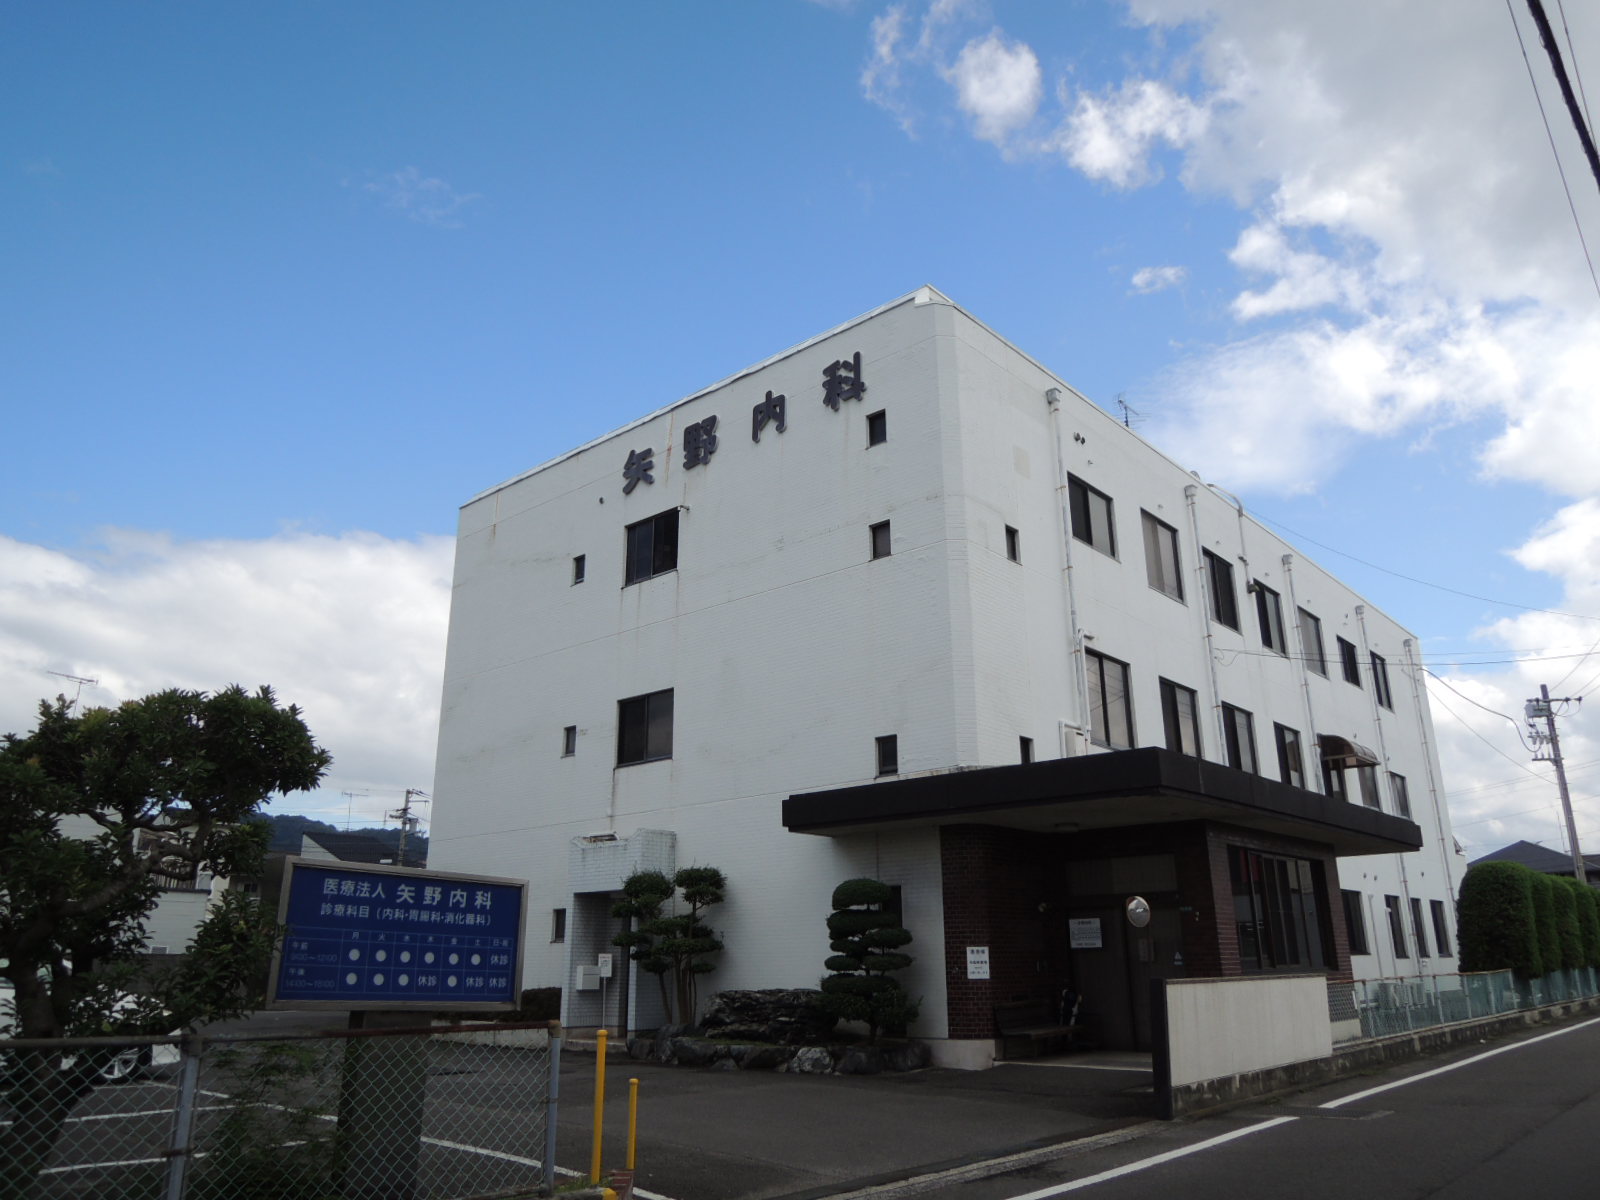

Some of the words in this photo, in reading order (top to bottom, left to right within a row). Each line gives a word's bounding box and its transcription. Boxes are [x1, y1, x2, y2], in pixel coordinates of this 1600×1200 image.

[622, 351, 868, 495] 矢野内科
[323, 877, 386, 899] 医療法人
[395, 883, 492, 910] 矢野内科
[351, 931, 360, 940] 月
[490, 954, 508, 966] 休診
[417, 975, 437, 987] 休診
[465, 976, 484, 987] 休診
[489, 977, 507, 988] 休診
